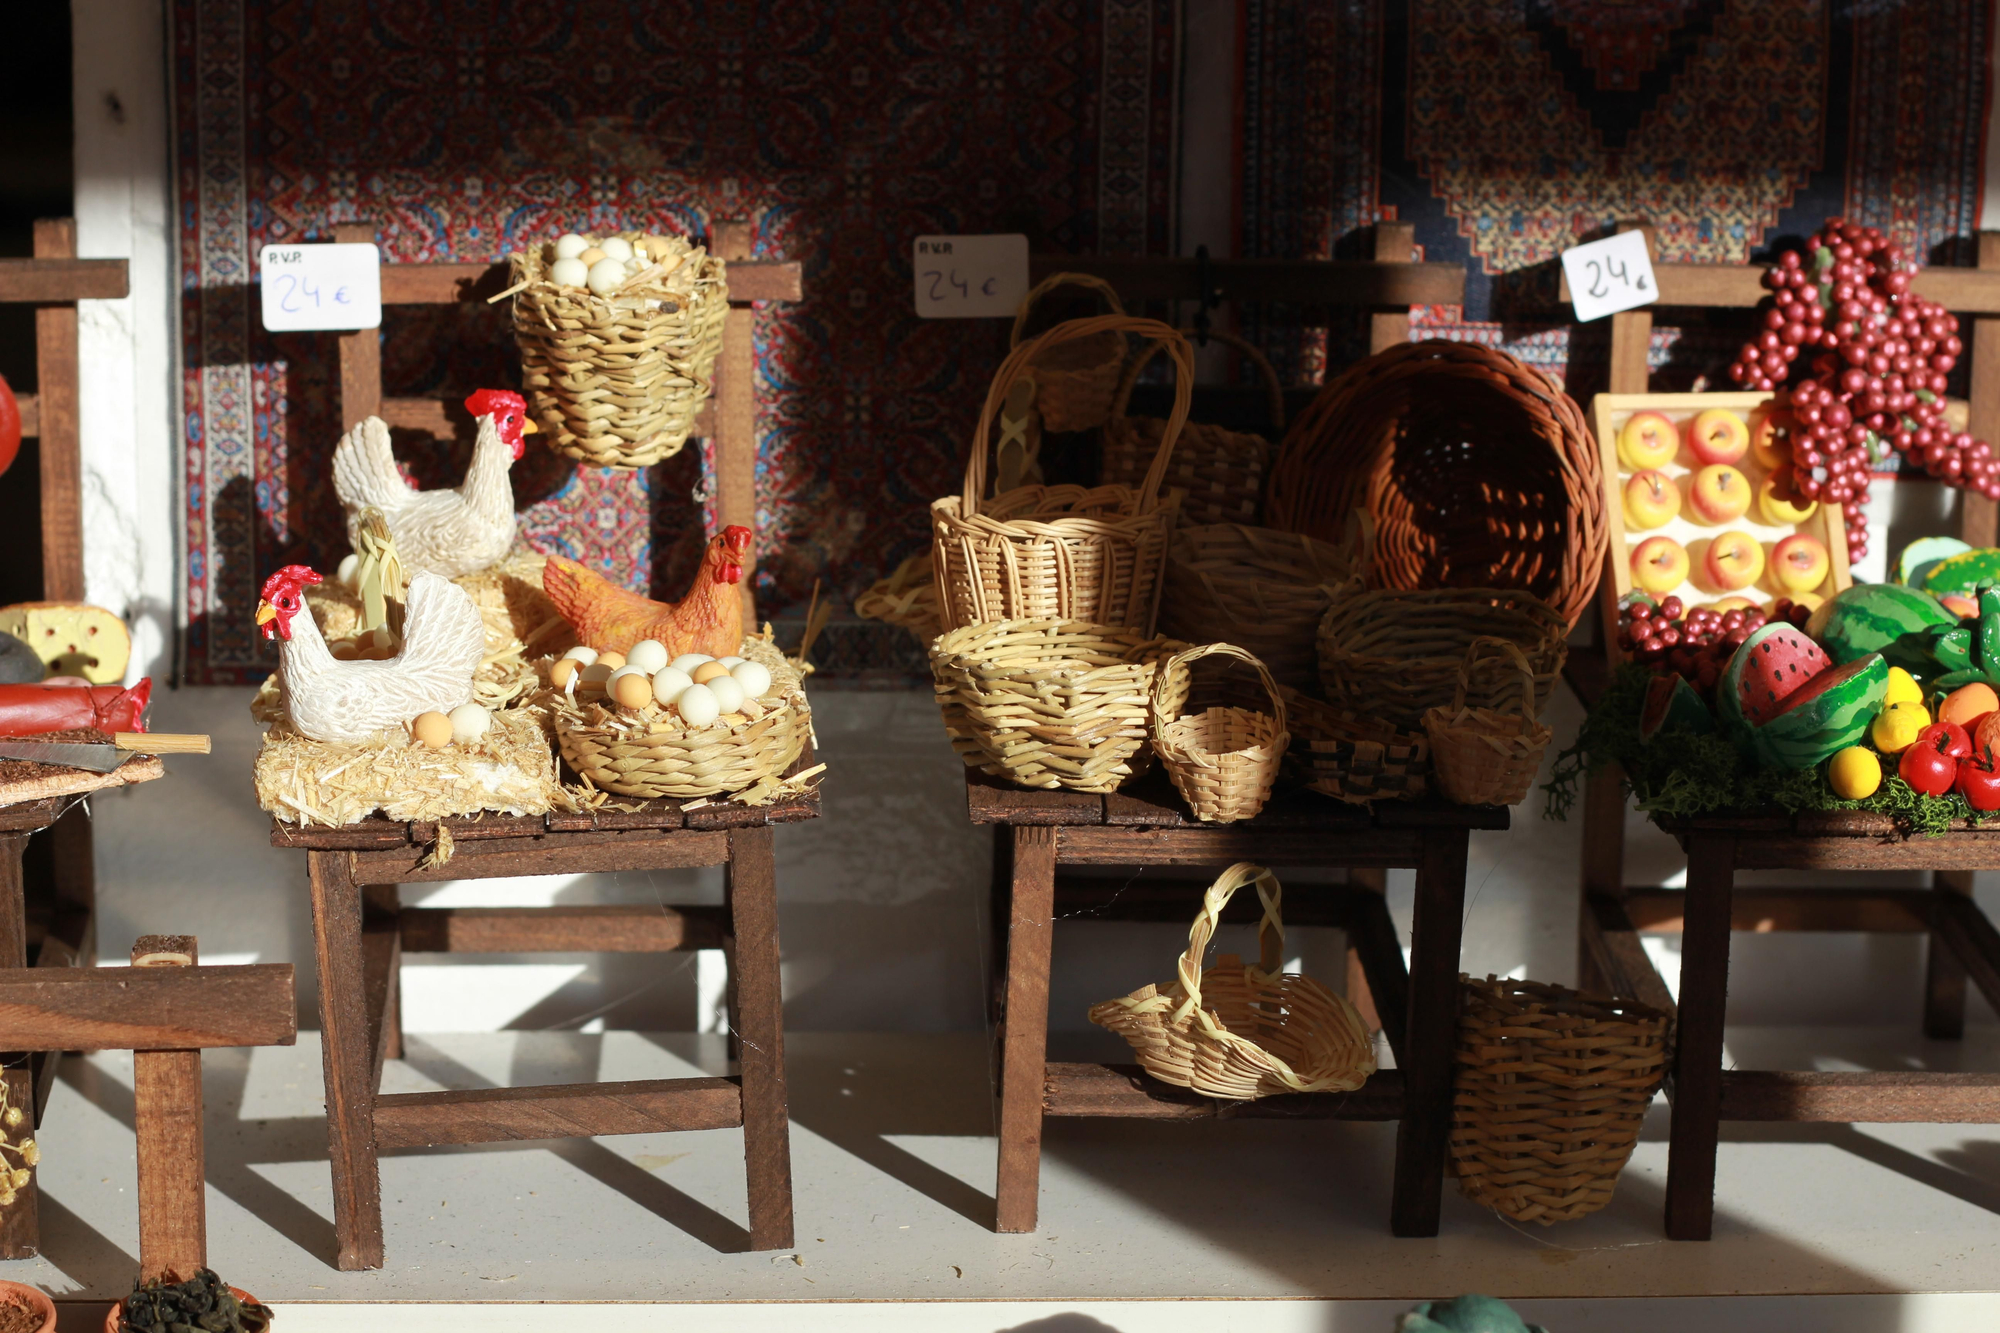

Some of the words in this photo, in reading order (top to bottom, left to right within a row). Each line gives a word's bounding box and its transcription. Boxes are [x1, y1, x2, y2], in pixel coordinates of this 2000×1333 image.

[273, 273, 320, 313] 24
[333, 285, 351, 304] €
[923, 268, 968, 301] 24
[1585, 254, 1629, 298] 24
